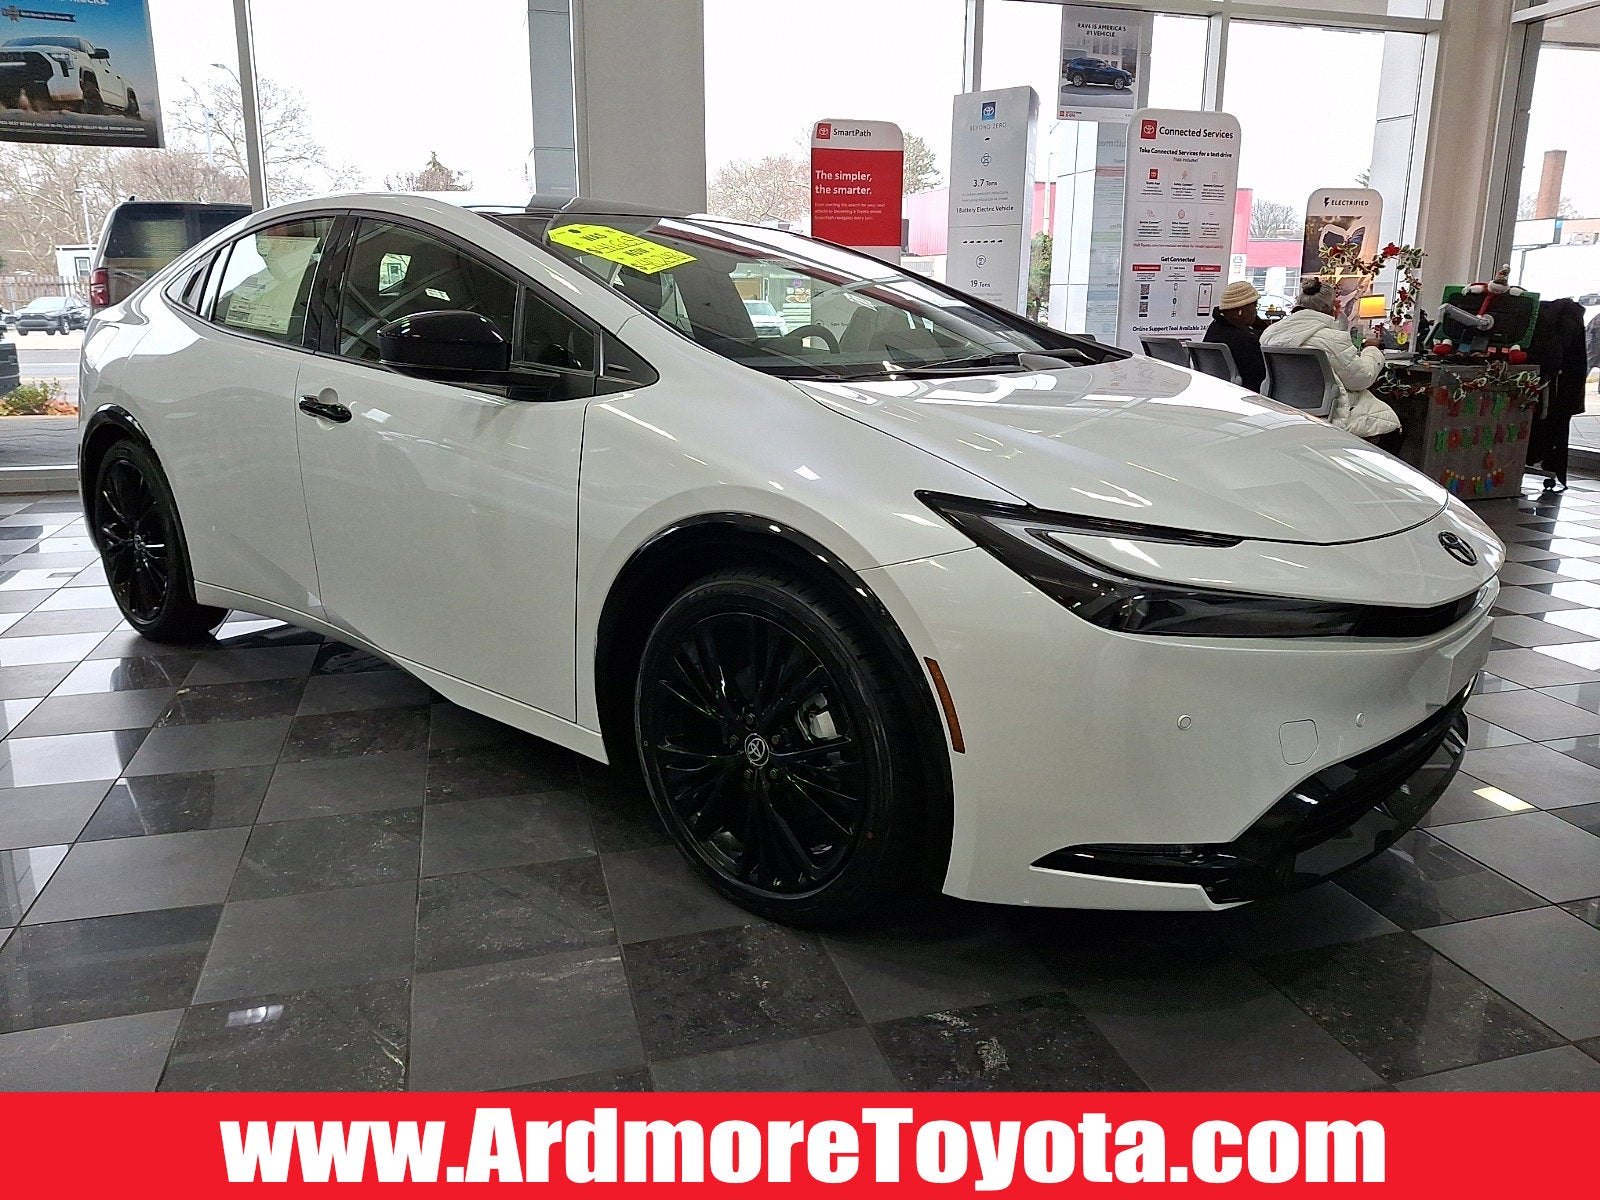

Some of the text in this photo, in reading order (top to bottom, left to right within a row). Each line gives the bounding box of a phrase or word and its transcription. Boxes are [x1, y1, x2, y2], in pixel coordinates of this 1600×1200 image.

[993, 121, 1007, 129] ZERO
[833, 128, 872, 137] SmartPath
[1159, 126, 1234, 139] Connected Services
[815, 170, 873, 183] The simpler,
[973, 179, 985, 188] 3.7
[815, 184, 872, 195] the smarter.
